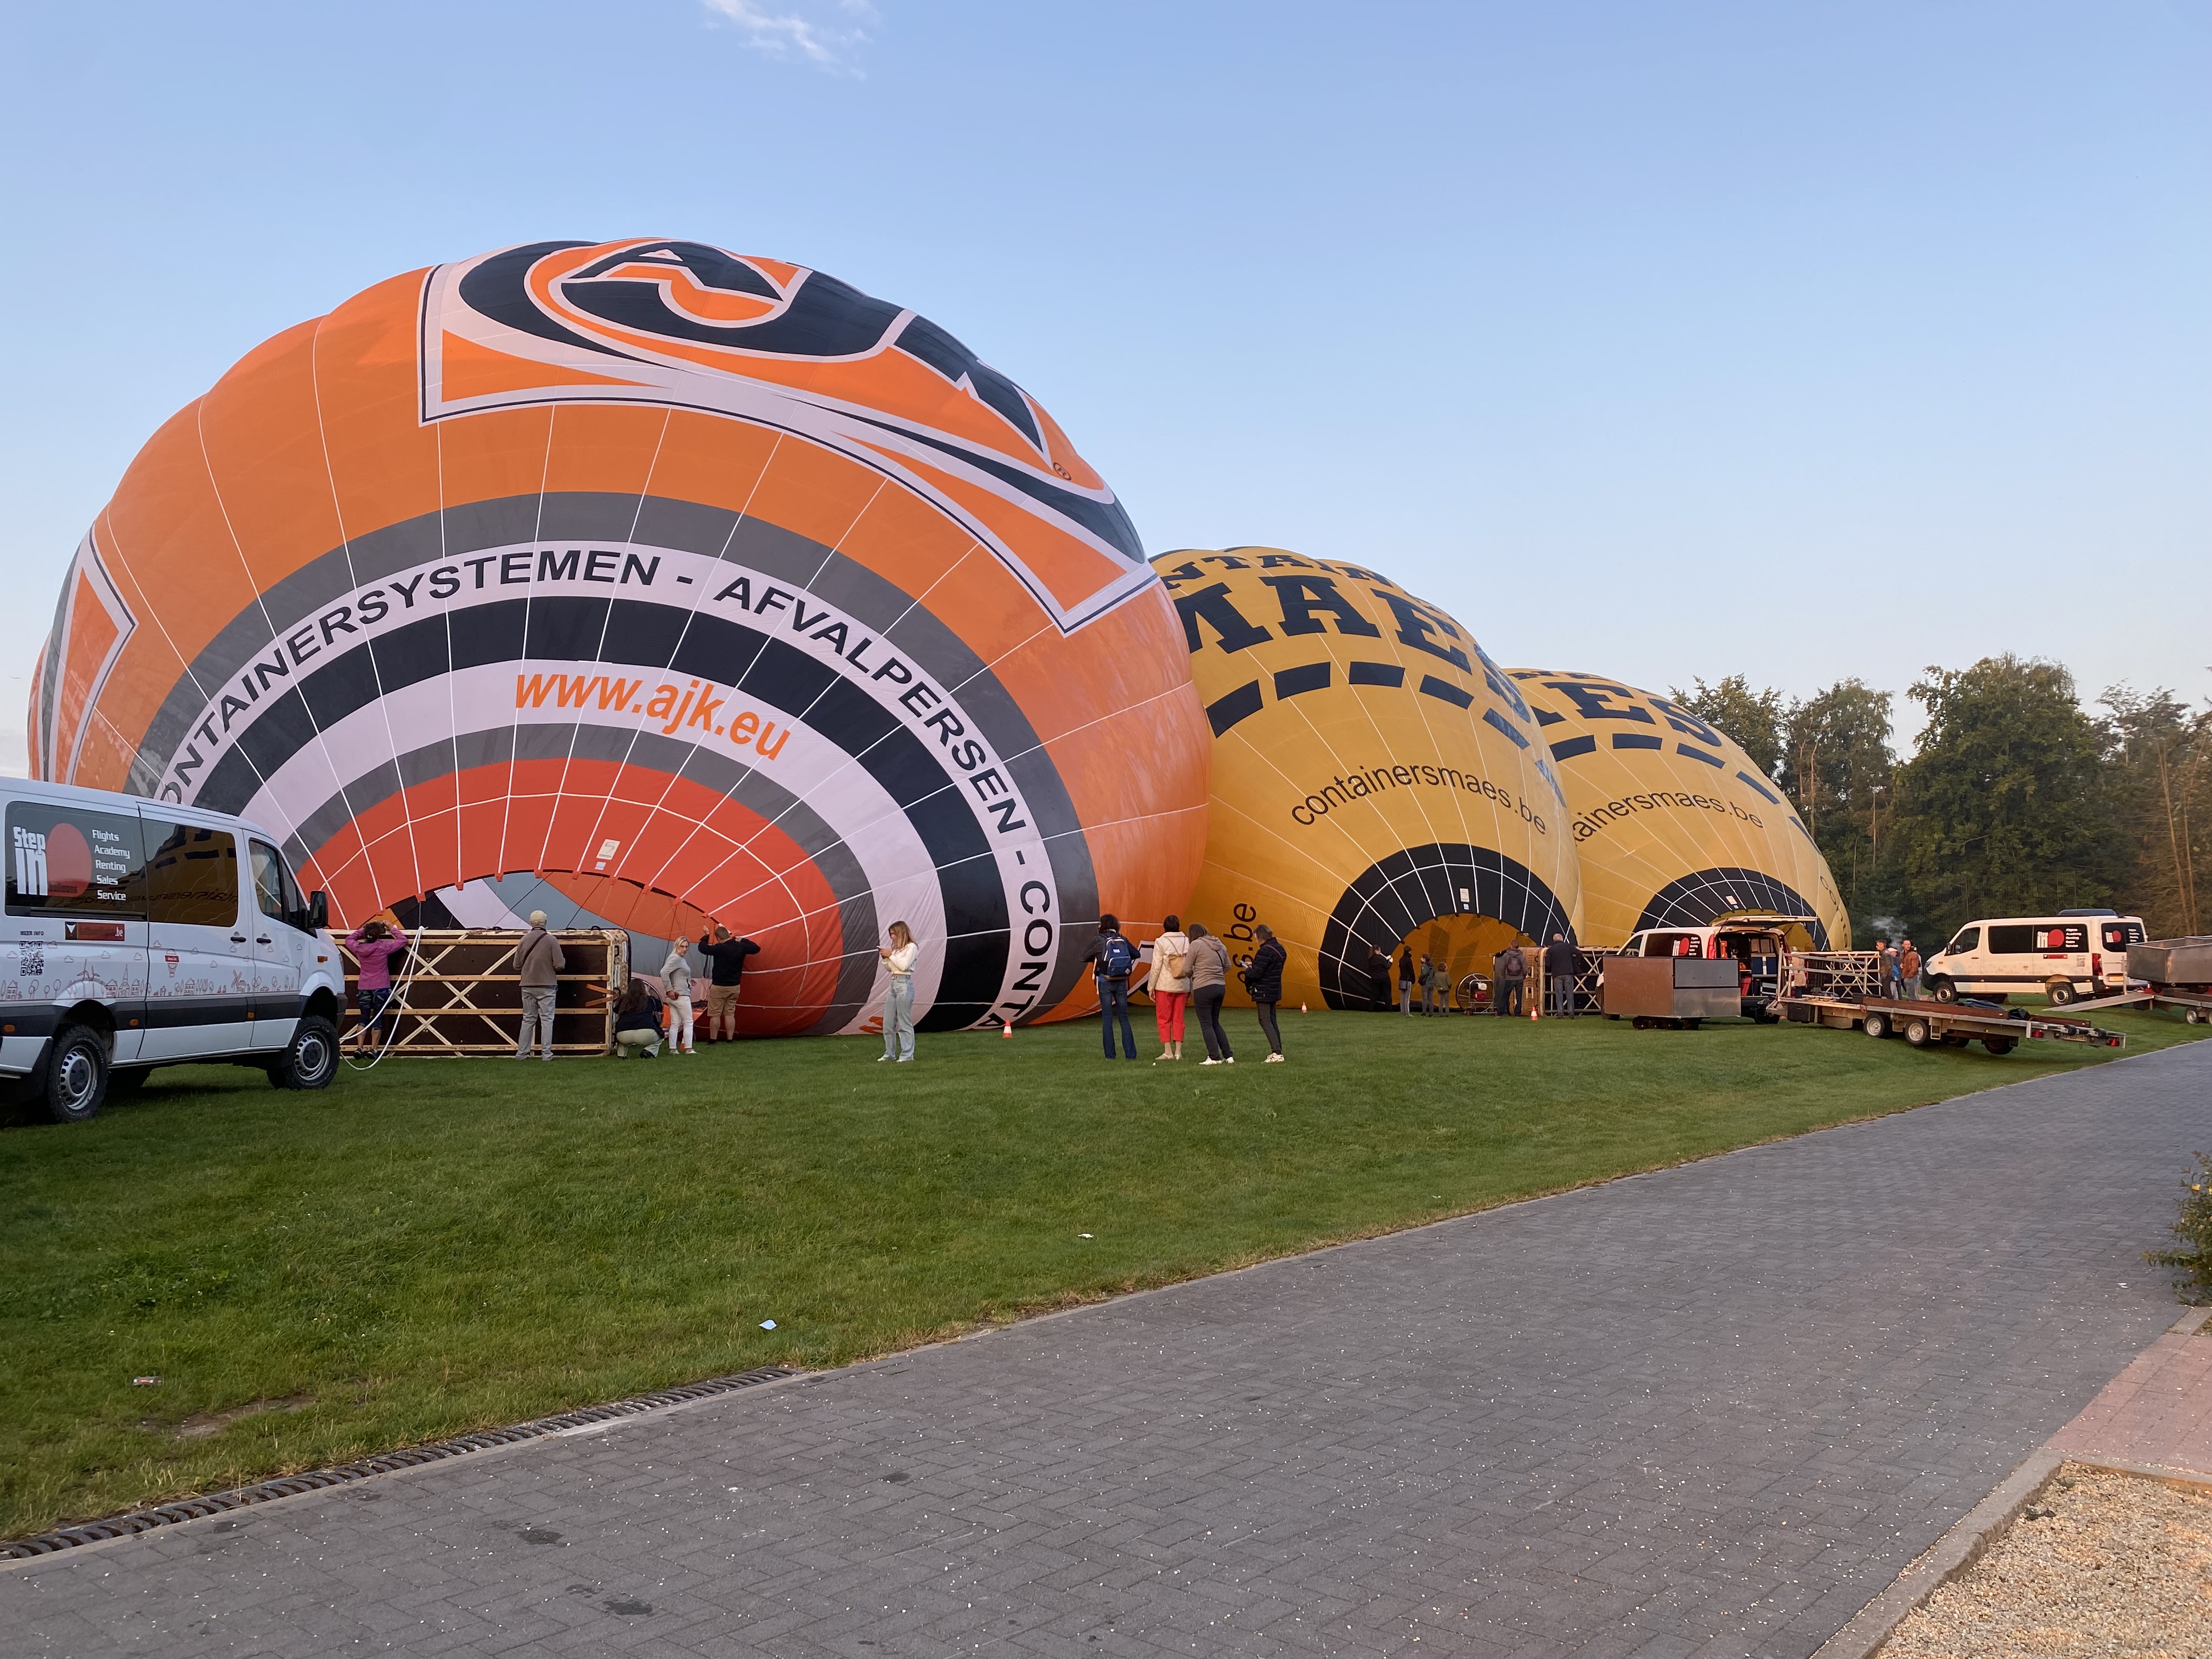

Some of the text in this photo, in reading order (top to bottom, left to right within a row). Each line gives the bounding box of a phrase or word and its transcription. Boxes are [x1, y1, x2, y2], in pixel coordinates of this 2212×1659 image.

[714, 577, 1026, 834] AFVALPERSEN
[516, 674, 791, 760] www.ajk.eu
[1291, 765, 1545, 834] containersmaes.be
[13, 826, 46, 855] Step
[92, 829, 119, 842] Flights
[94, 845, 130, 859] Academy
[15, 848, 48, 895] in
[95, 860, 126, 873] Renting
[97, 875, 118, 885] Sales
[97, 890, 126, 901] Service
